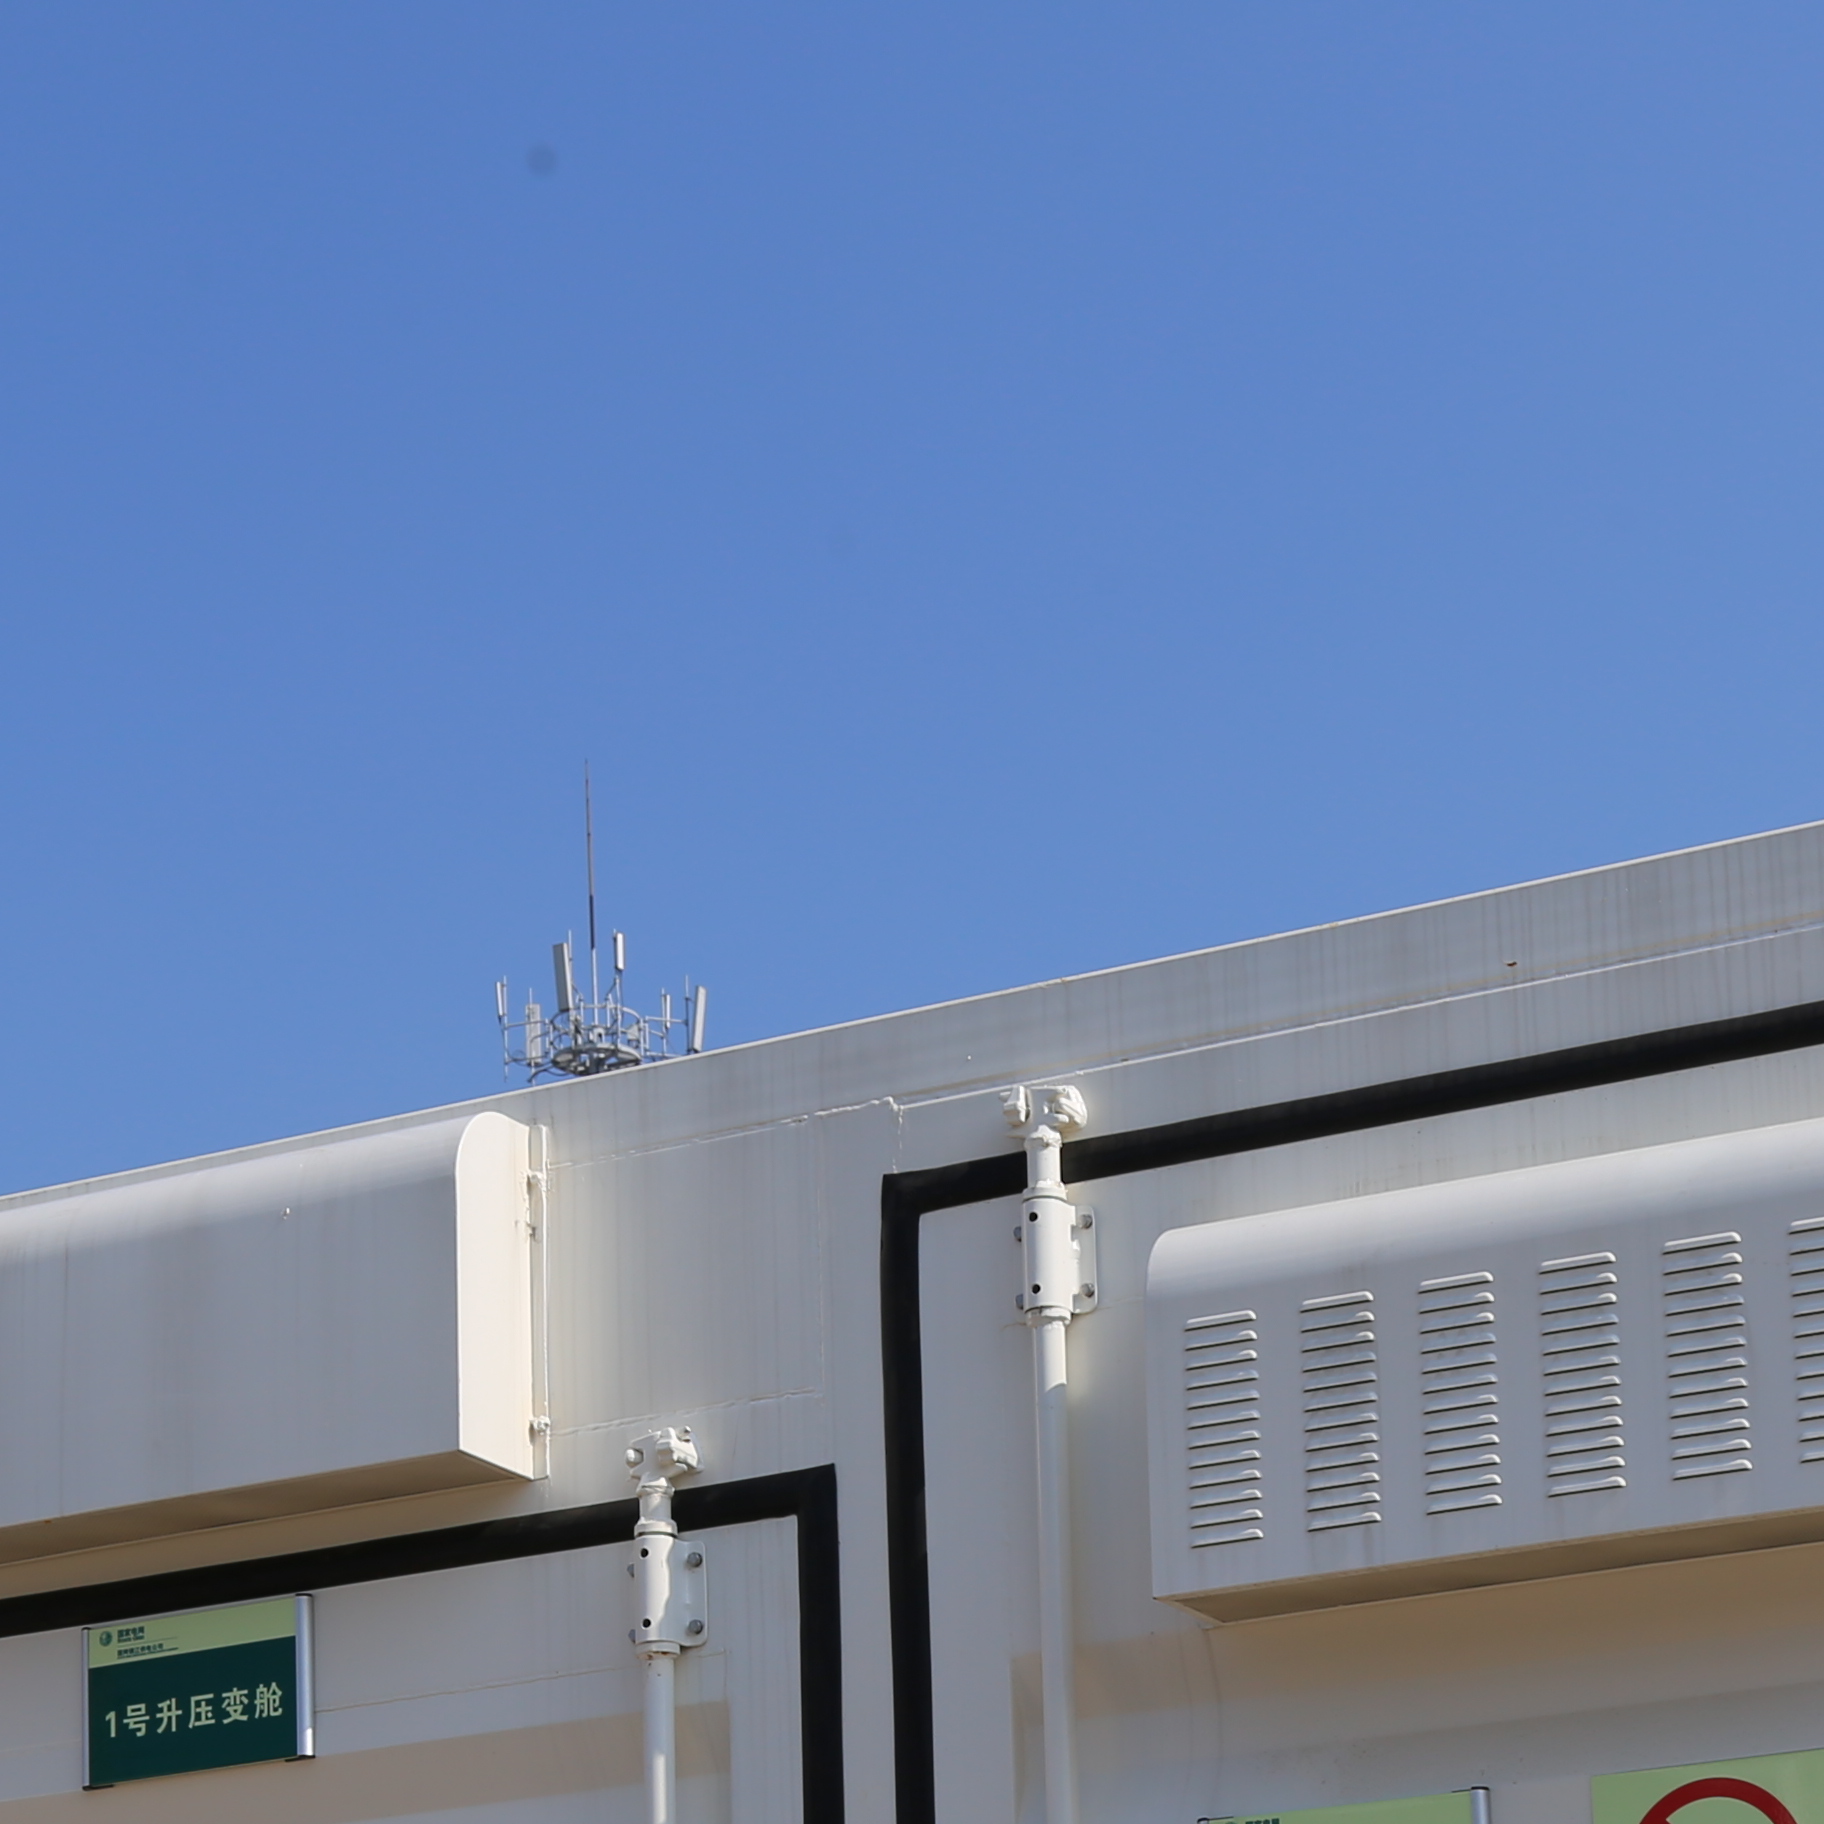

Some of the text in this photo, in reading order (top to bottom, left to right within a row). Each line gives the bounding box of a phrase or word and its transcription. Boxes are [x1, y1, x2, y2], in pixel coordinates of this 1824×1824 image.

[105, 1682, 283, 1738] 1号升压变舱
